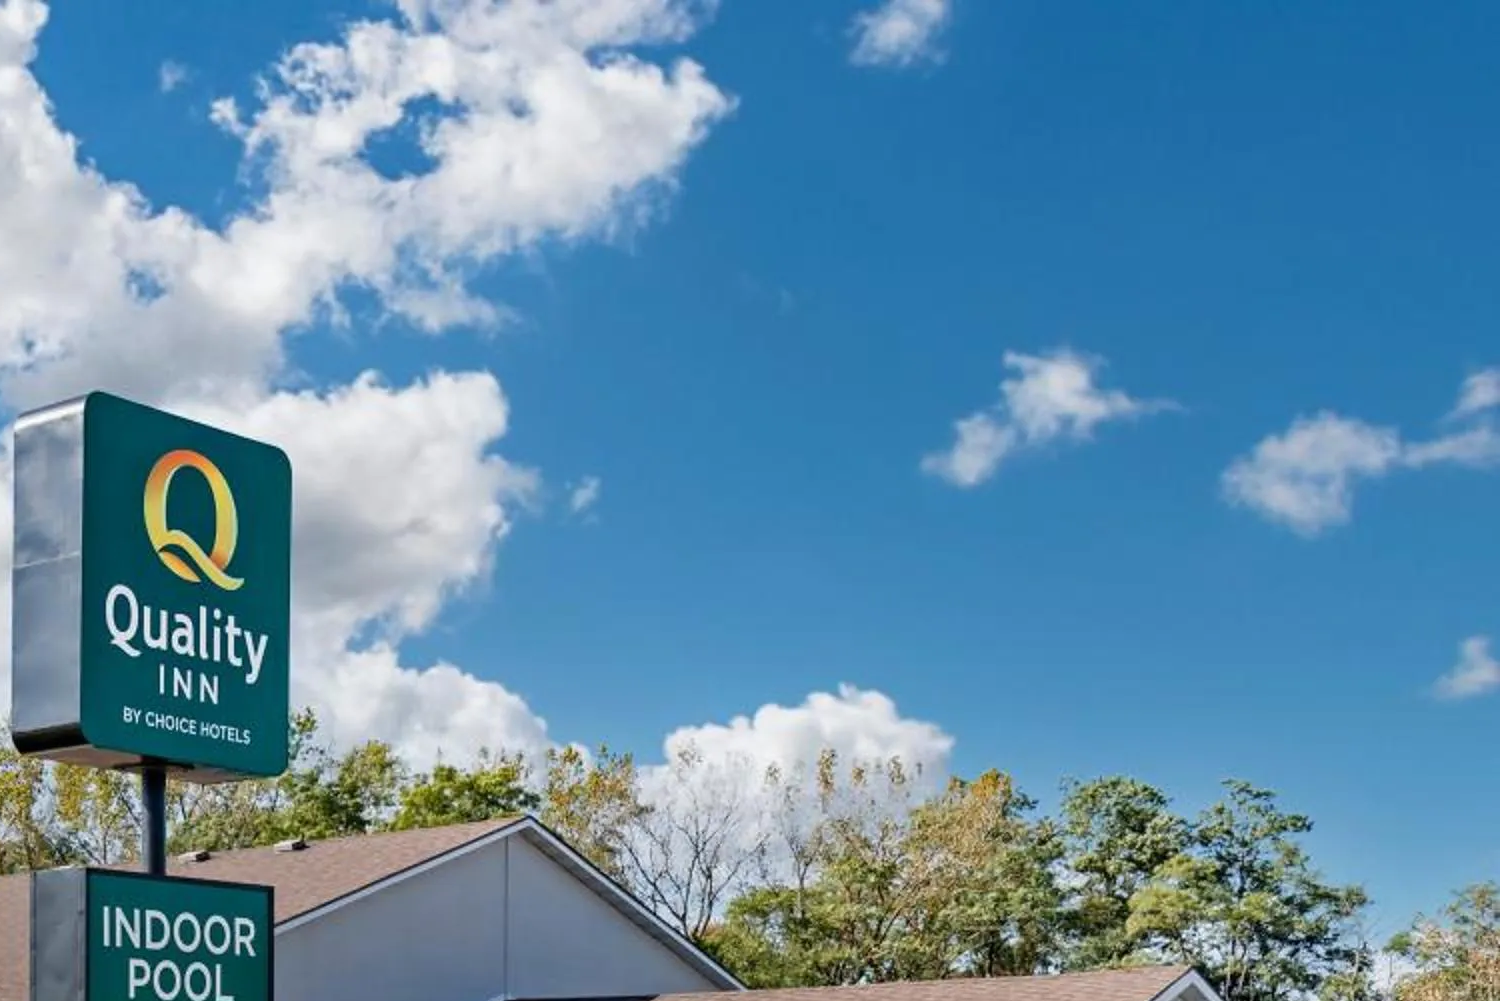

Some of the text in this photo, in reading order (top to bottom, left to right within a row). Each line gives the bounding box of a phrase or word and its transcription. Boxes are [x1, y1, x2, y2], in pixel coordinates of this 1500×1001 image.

[143, 449, 244, 590] Q
[105, 584, 268, 684] Quality
[159, 664, 218, 704] INN
[123, 707, 251, 745] BY CHOICE HOTELS
[103, 905, 257, 957] INDOOR
